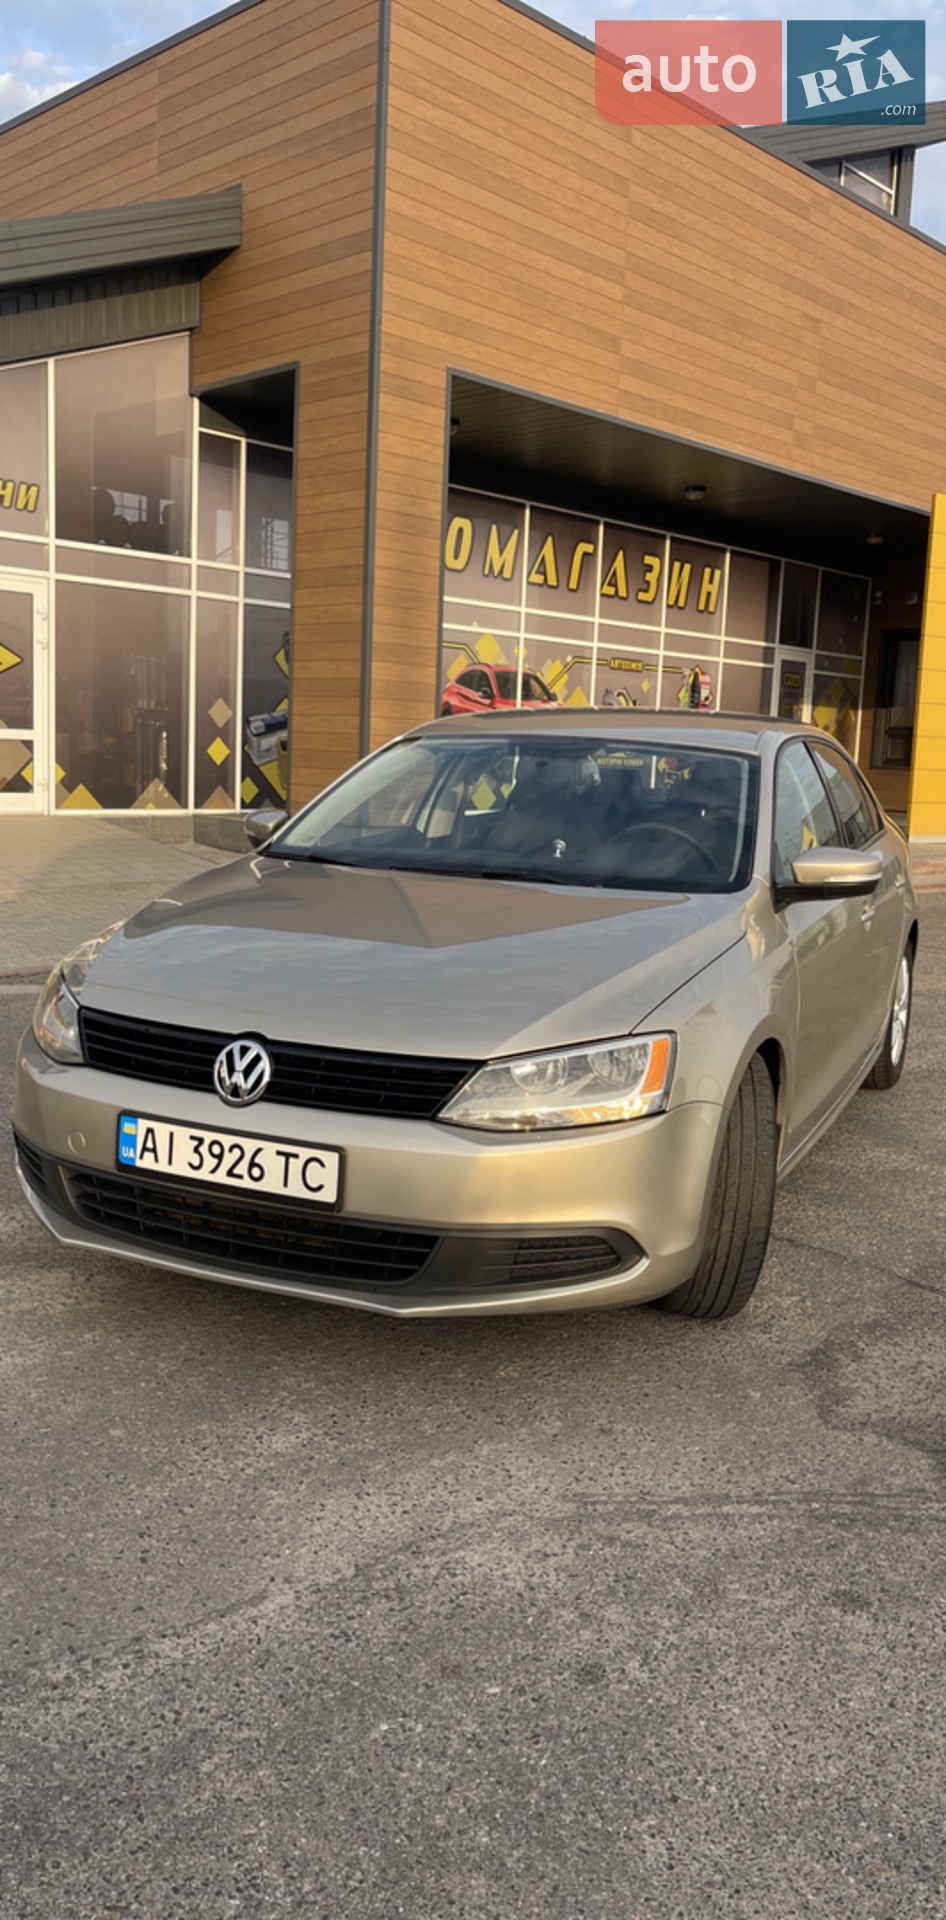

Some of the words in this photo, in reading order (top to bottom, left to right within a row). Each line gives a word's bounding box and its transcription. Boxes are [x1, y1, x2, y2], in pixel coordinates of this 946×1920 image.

[121, 1145, 135, 1159] UA
[139, 1127, 174, 1166] AI
[187, 1135, 265, 1183] 3926
[275, 1150, 327, 1193] TC
